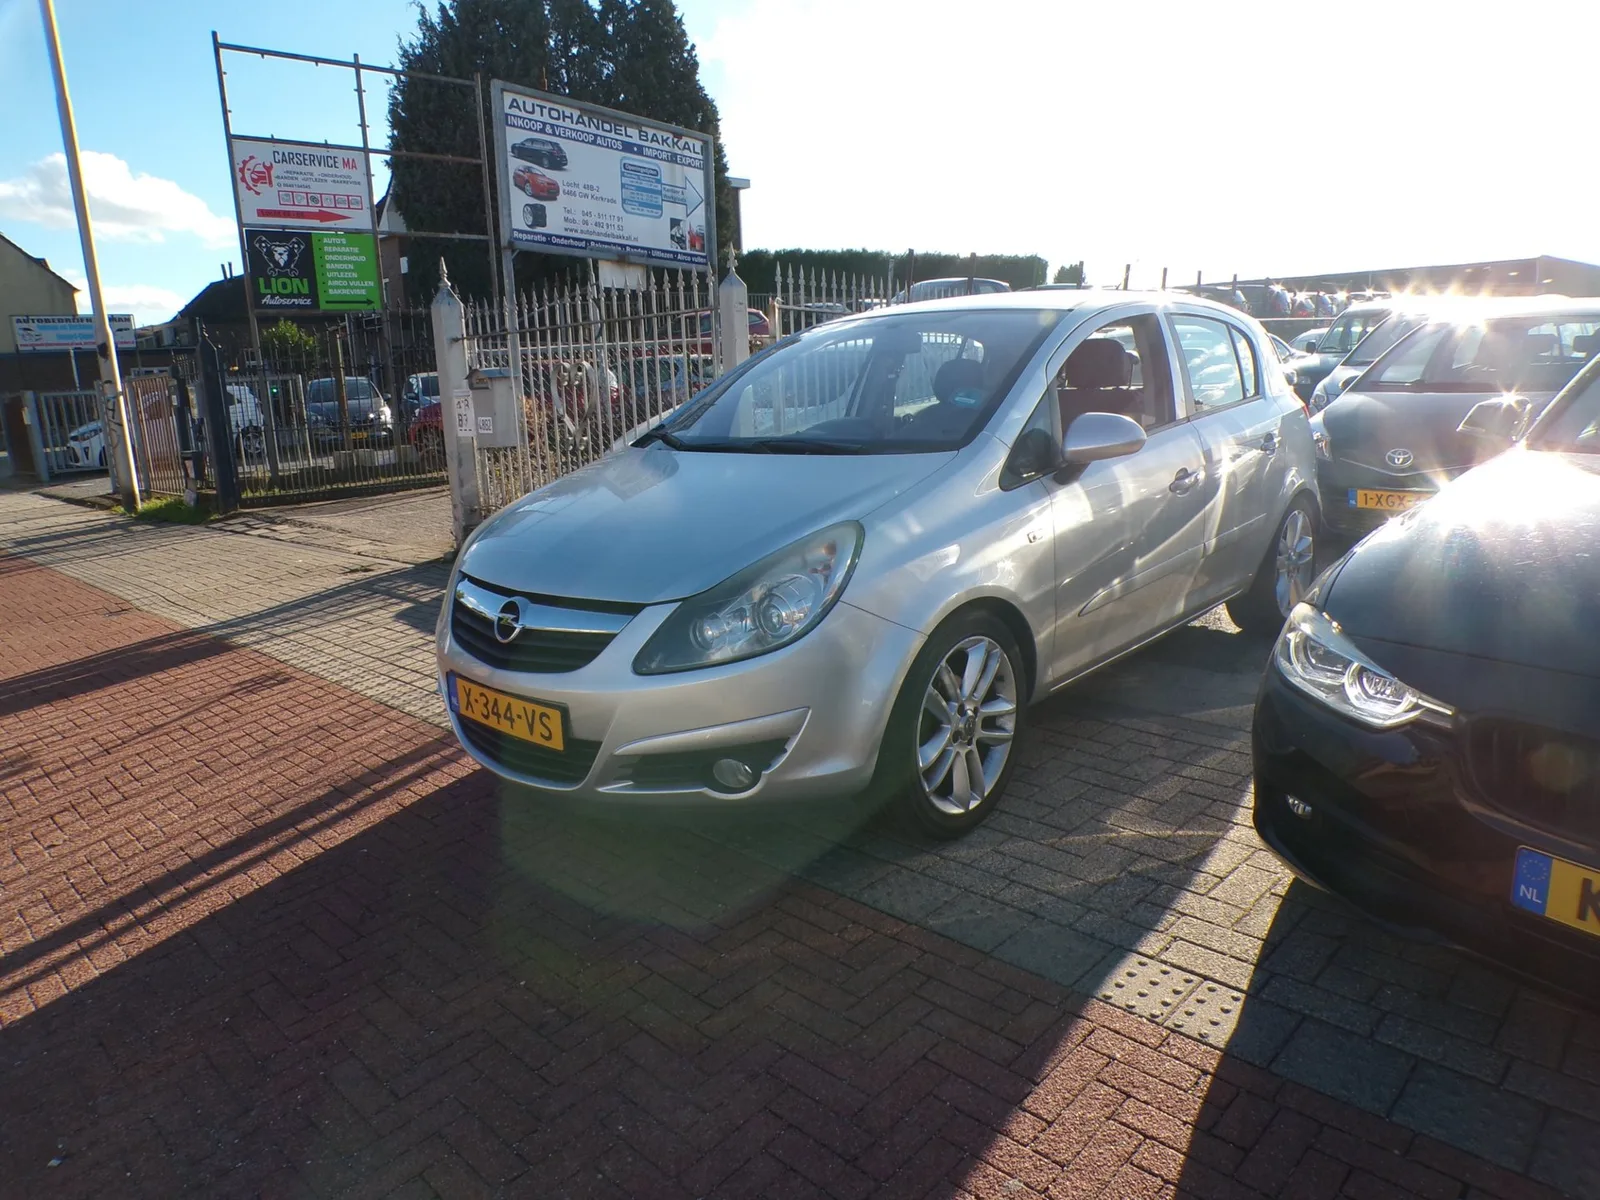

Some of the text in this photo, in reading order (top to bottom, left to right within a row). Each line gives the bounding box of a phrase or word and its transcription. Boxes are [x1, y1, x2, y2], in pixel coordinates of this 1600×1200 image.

[508, 98, 704, 157] AUTOHANDEL BAKKALI
[507, 115, 704, 169] INKOOP & VERKOOP AUTOS IMPORT EXPORT
[272, 150, 358, 170] CARSERVICE MA
[562, 180, 600, 193] Locht 48B-2
[562, 188, 577, 198] 6466
[578, 191, 590, 200] GW
[590, 192, 617, 204] Kerkrade
[581, 209, 592, 218] 045
[597, 211, 607, 220] 511
[608, 213, 615, 221] 17
[616, 214, 624, 223] 91
[581, 218, 589, 226] 06
[594, 220, 605, 229] 492
[606, 222, 616, 231] 911
[513, 231, 547, 243] Reparatie
[551, 236, 586, 248] Onderhoud
[651, 249, 674, 259] Uitlezen
[677, 253, 691, 262] Airco
[258, 277, 309, 294] LION
[261, 294, 312, 305] Autoservice
[462, 685, 553, 741] X-344-VS
[1520, 884, 1542, 904] NL
